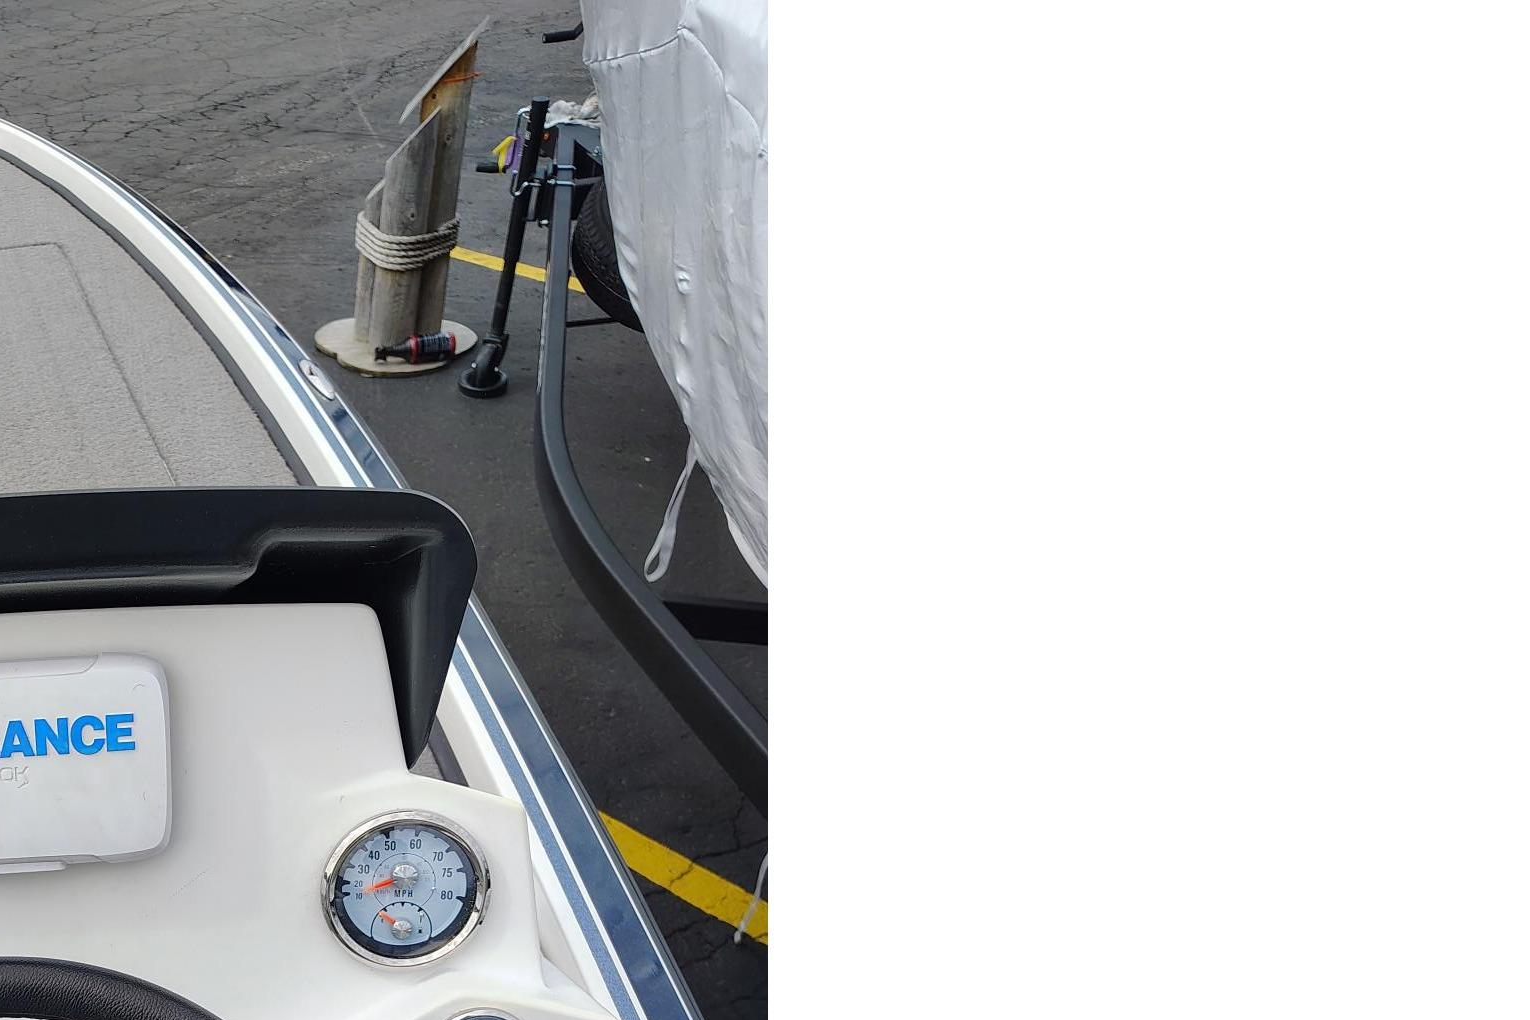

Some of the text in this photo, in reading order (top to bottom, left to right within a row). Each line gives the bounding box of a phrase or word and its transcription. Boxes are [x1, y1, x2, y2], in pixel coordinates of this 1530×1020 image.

[384, 840, 397, 851] 50
[409, 838, 422, 850] 60
[368, 850, 380, 861] 40
[432, 851, 444, 862] 70
[357, 864, 370, 875] 30
[441, 867, 453, 878] 75
[354, 880, 363, 888] 20
[355, 892, 363, 900] 10
[393, 889, 413, 898] MPH
[440, 890, 453, 900] 80
